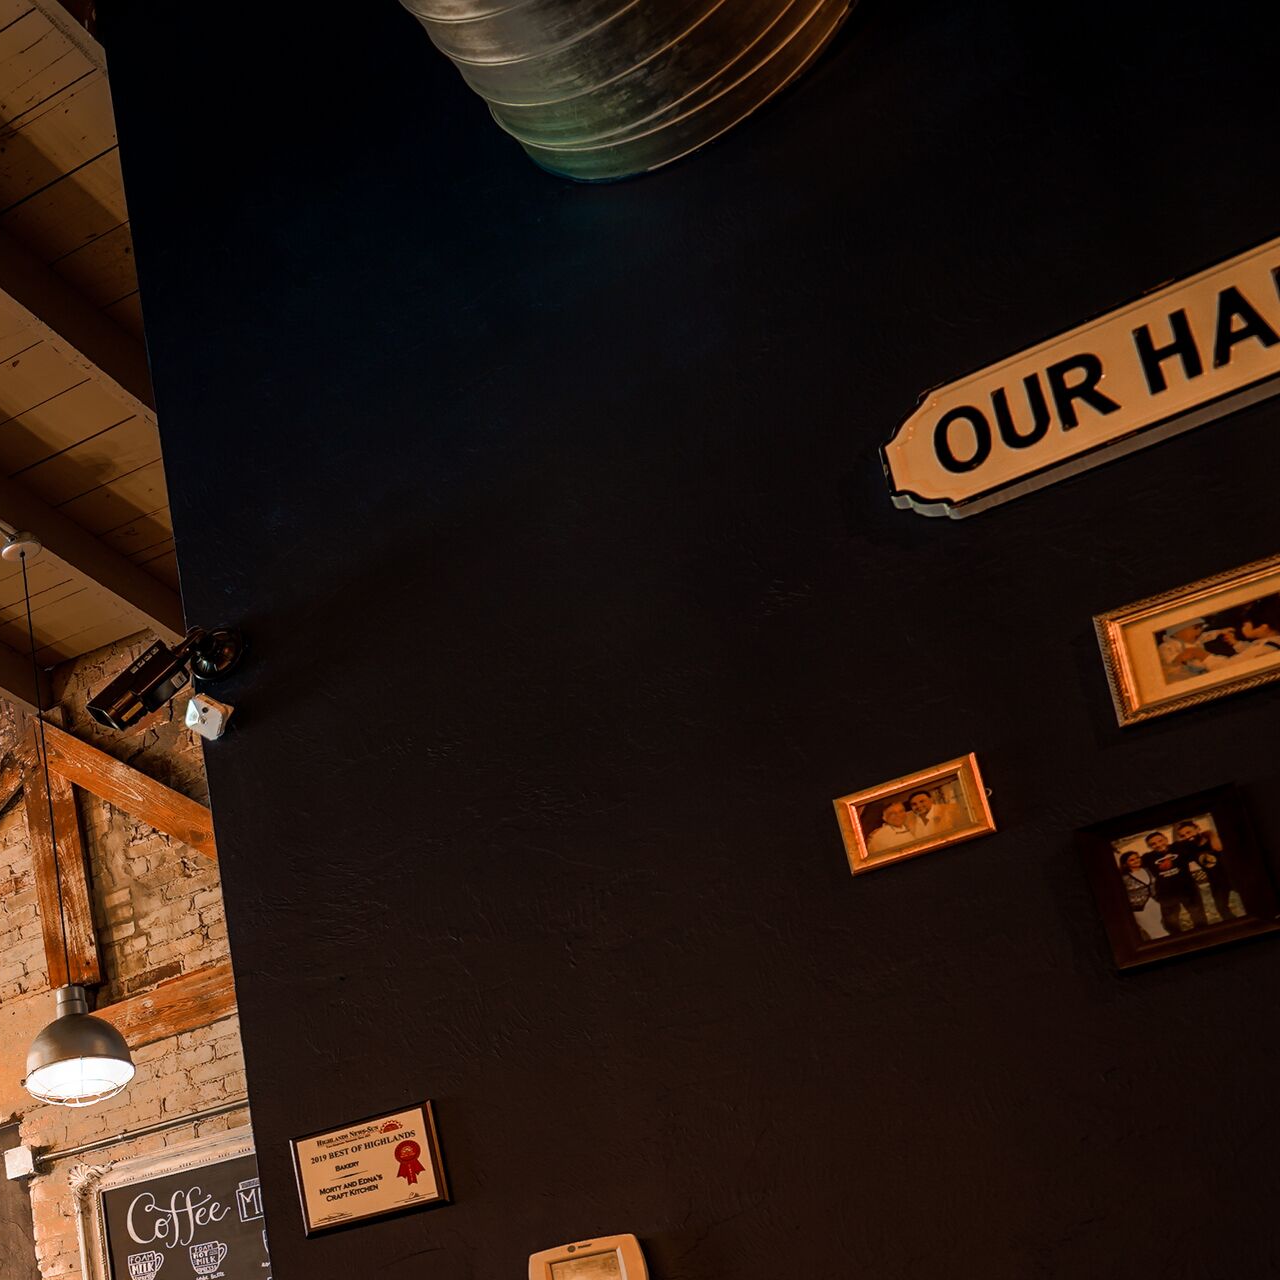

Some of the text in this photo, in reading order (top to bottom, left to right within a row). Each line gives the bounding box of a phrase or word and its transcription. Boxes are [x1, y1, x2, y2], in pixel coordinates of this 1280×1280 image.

[934, 352, 1122, 474] OUR
[310, 1154, 327, 1165] 2019
[329, 1147, 349, 1160] BEST
[351, 1144, 362, 1153] OF
[364, 1130, 416, 1151] HIGHLANDS
[335, 1160, 360, 1172] BAKERY
[319, 1174, 383, 1196] MORTY AND EDNA'S
[326, 1184, 379, 1202] CRAFT KITCHEN
[126, 1186, 231, 1249] Coffee
[129, 1253, 154, 1264] FOAM
[193, 1251, 209, 1261] HOT
[196, 1256, 216, 1267] MILK
[131, 1262, 155, 1276] MILK
